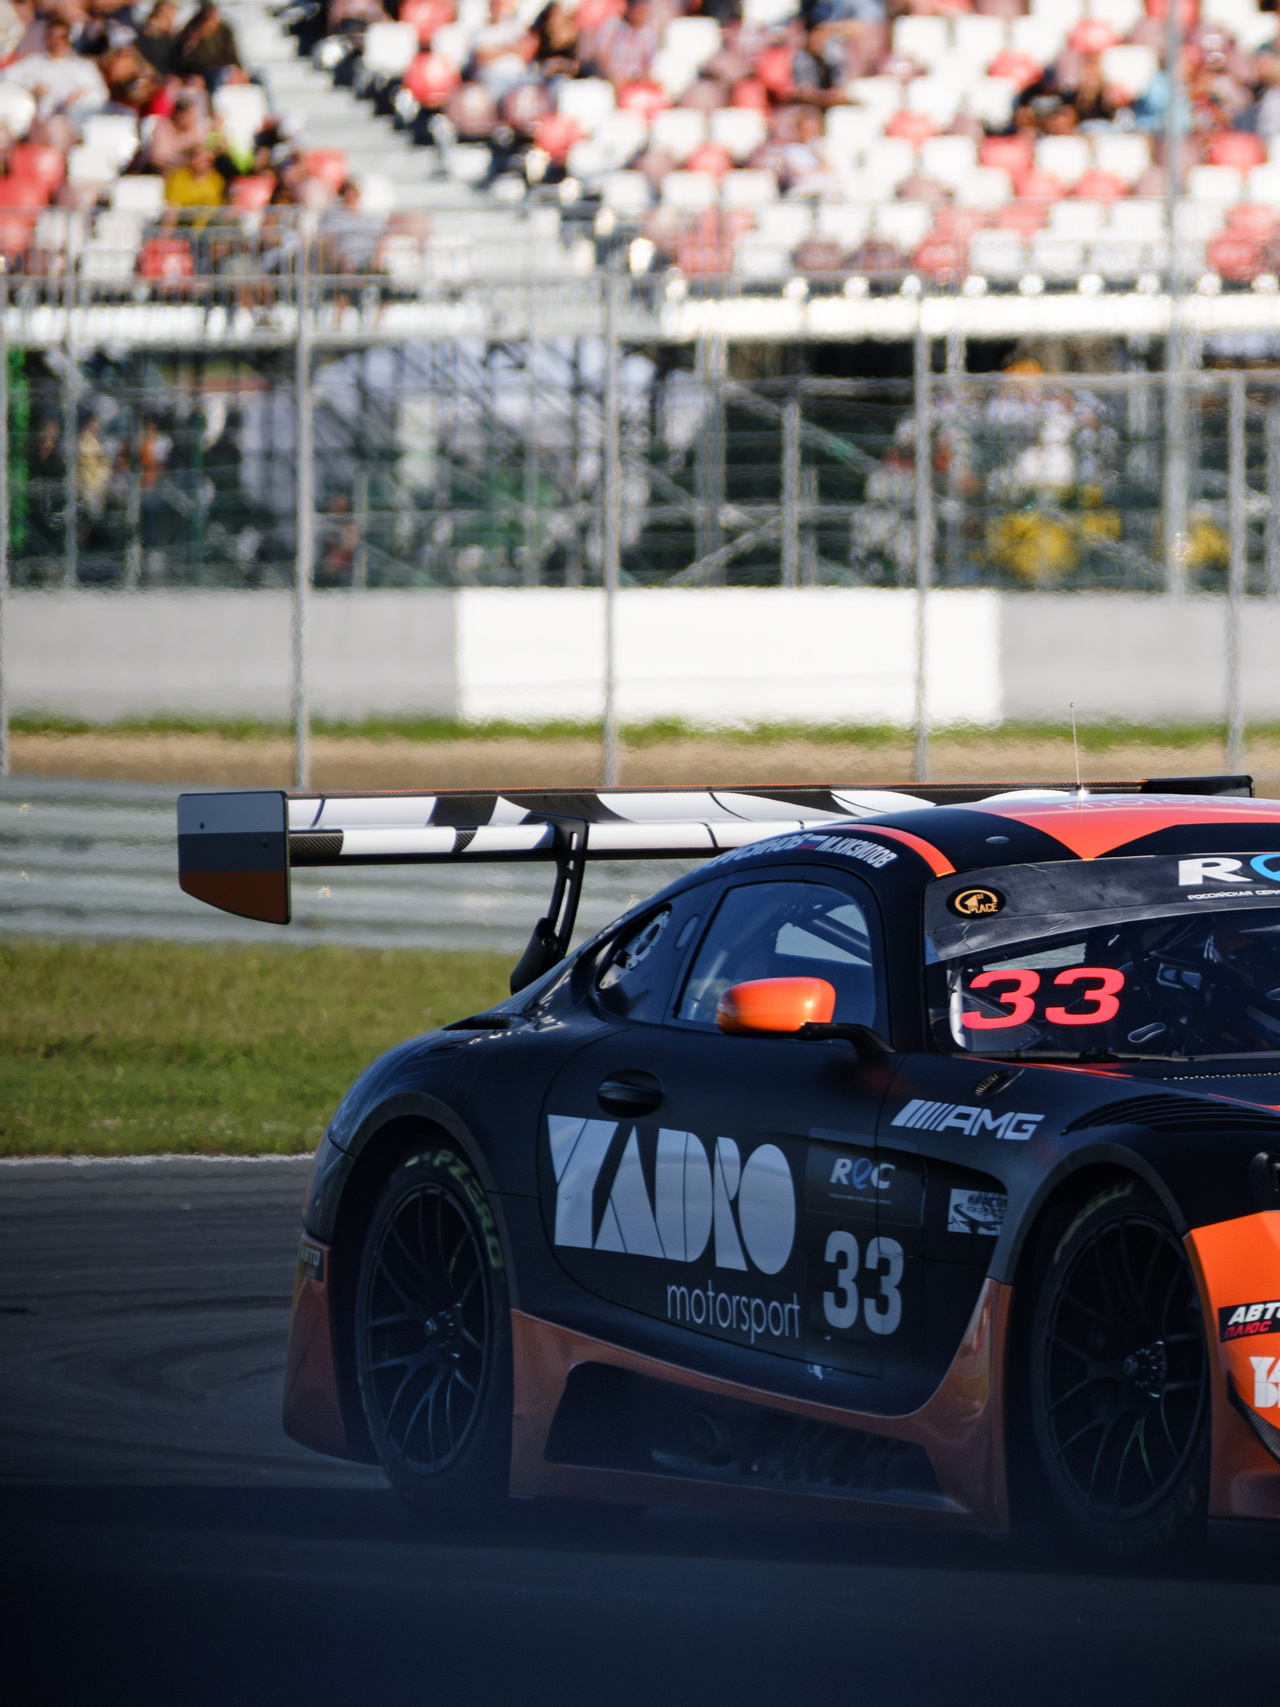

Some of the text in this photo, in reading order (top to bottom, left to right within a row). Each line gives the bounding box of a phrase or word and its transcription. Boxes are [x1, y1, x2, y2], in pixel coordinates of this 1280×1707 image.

[961, 967, 1126, 1030] 33
[548, 1114, 796, 1276] YADRO
[666, 1283, 800, 1345] motorsport
[823, 1231, 904, 1335] 33
